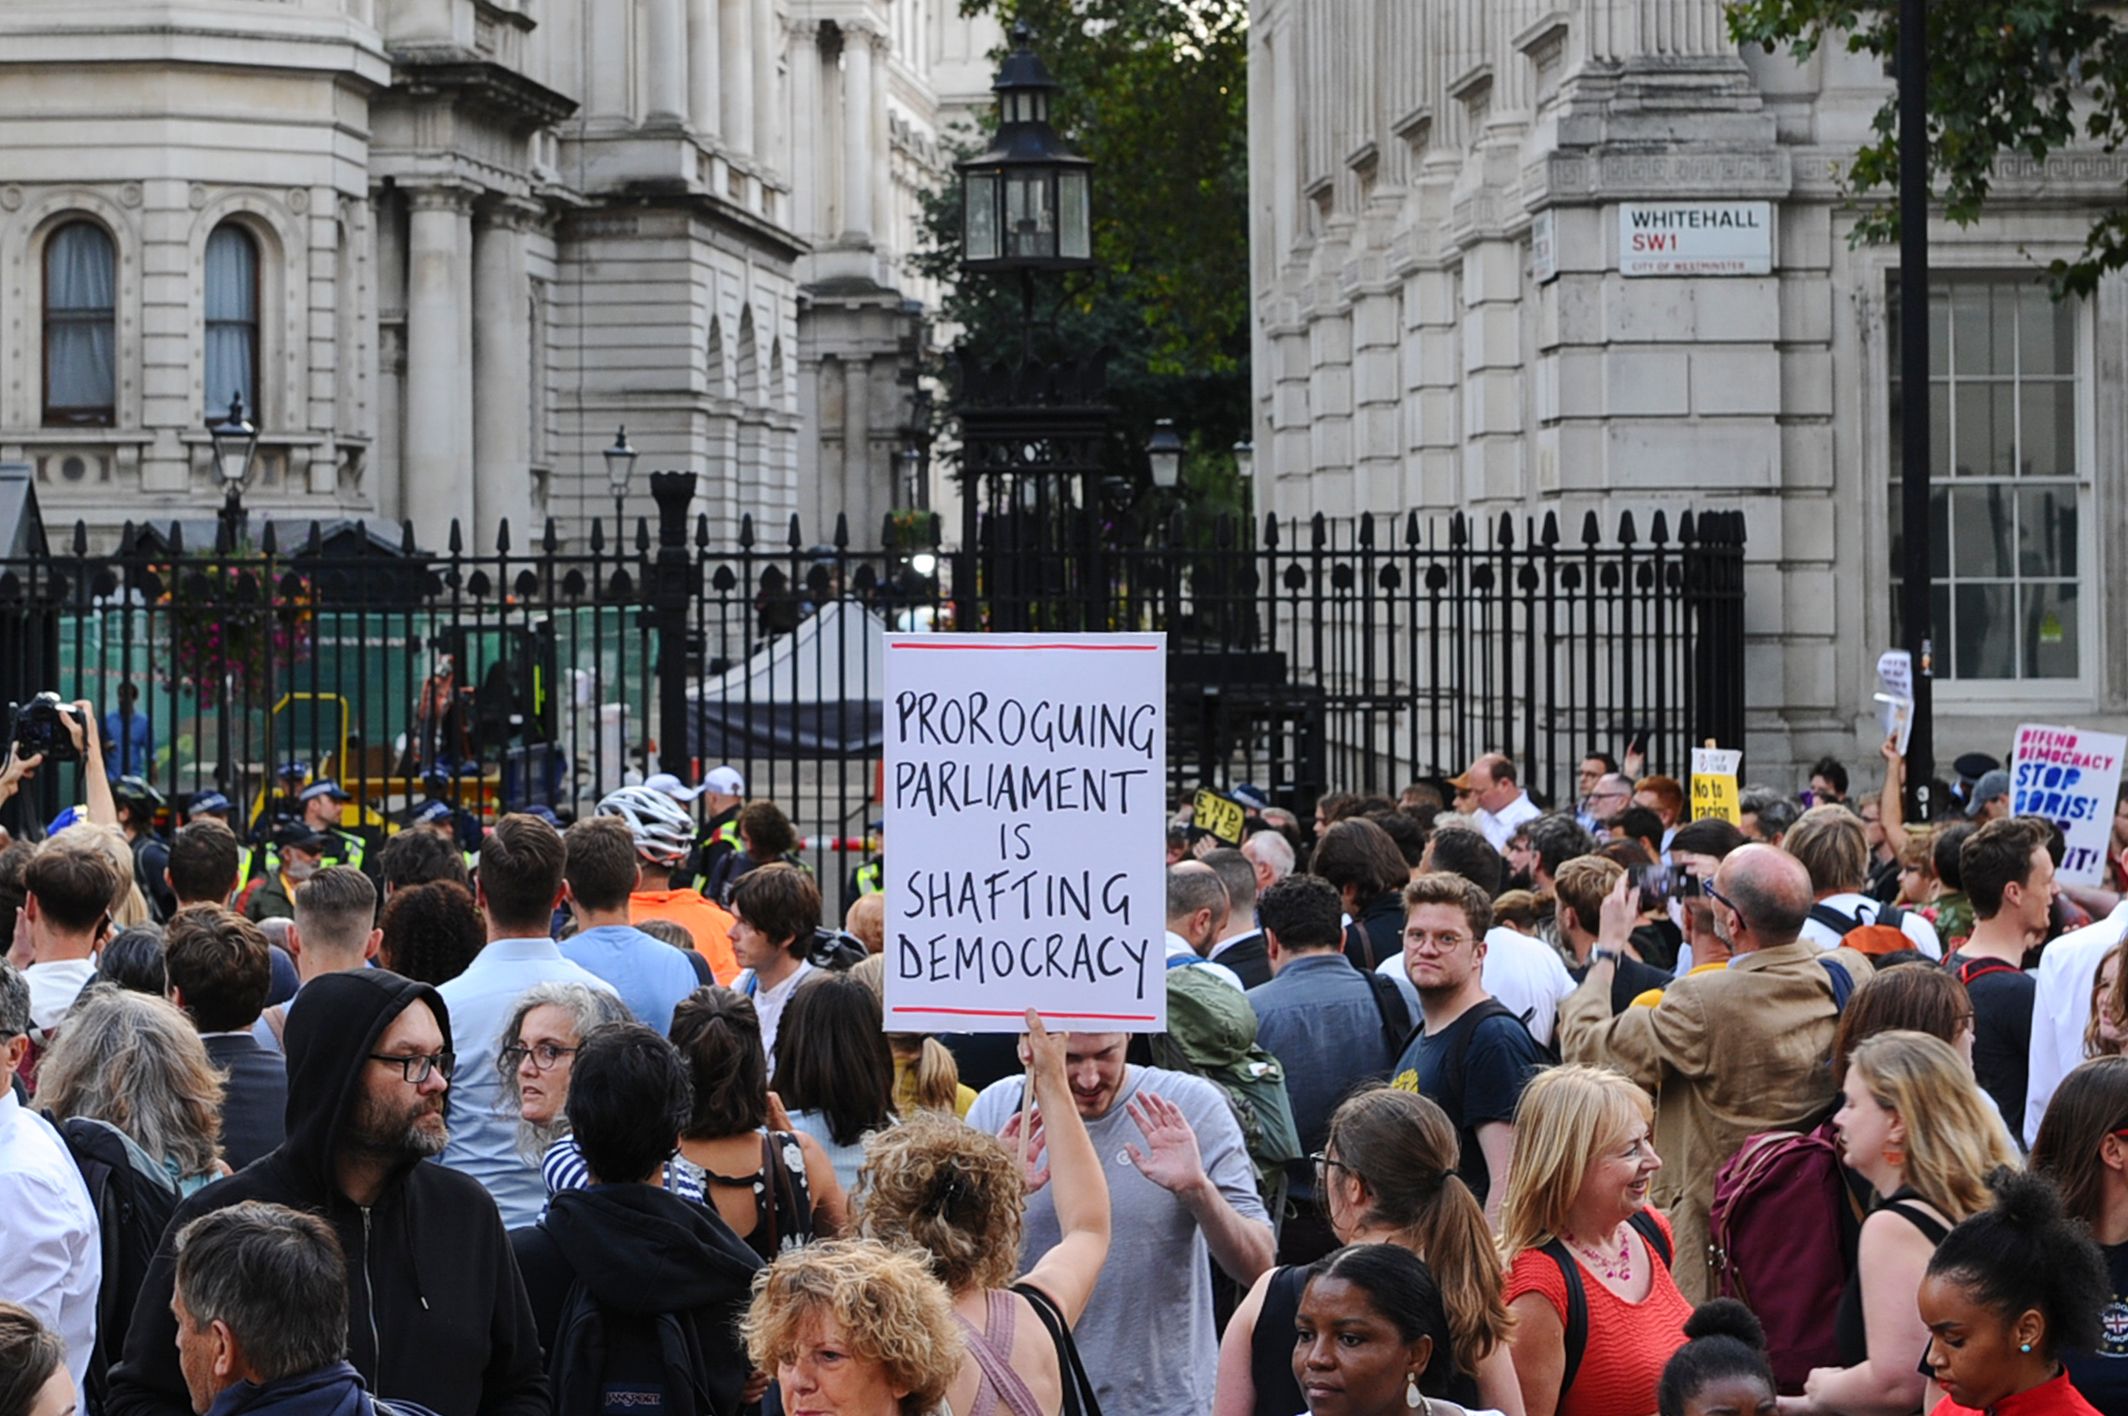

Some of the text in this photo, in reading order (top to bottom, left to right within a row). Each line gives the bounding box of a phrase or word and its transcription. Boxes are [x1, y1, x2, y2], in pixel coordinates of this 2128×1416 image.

[1631, 210, 1759, 228] WHITEHALL
[1632, 233, 1677, 251] SW1
[1632, 262, 1744, 272] CITY OF WESTMINSTER
[896, 690, 1156, 759] PROROGUING
[2020, 730, 2078, 748] DEFEND
[2018, 747, 2114, 771] DEMOCRACY
[896, 761, 1148, 816] PARLIAMENT
[1694, 779, 1723, 798] No to
[2016, 763, 2081, 790] STOP
[1197, 793, 1238, 822] END
[1695, 800, 1729, 820] racism
[2014, 790, 2099, 820] BORIS!
[1000, 823, 1032, 860] IS
[904, 870, 1130, 926] SHAFTING
[898, 933, 1149, 1000] DEMOCRACY
